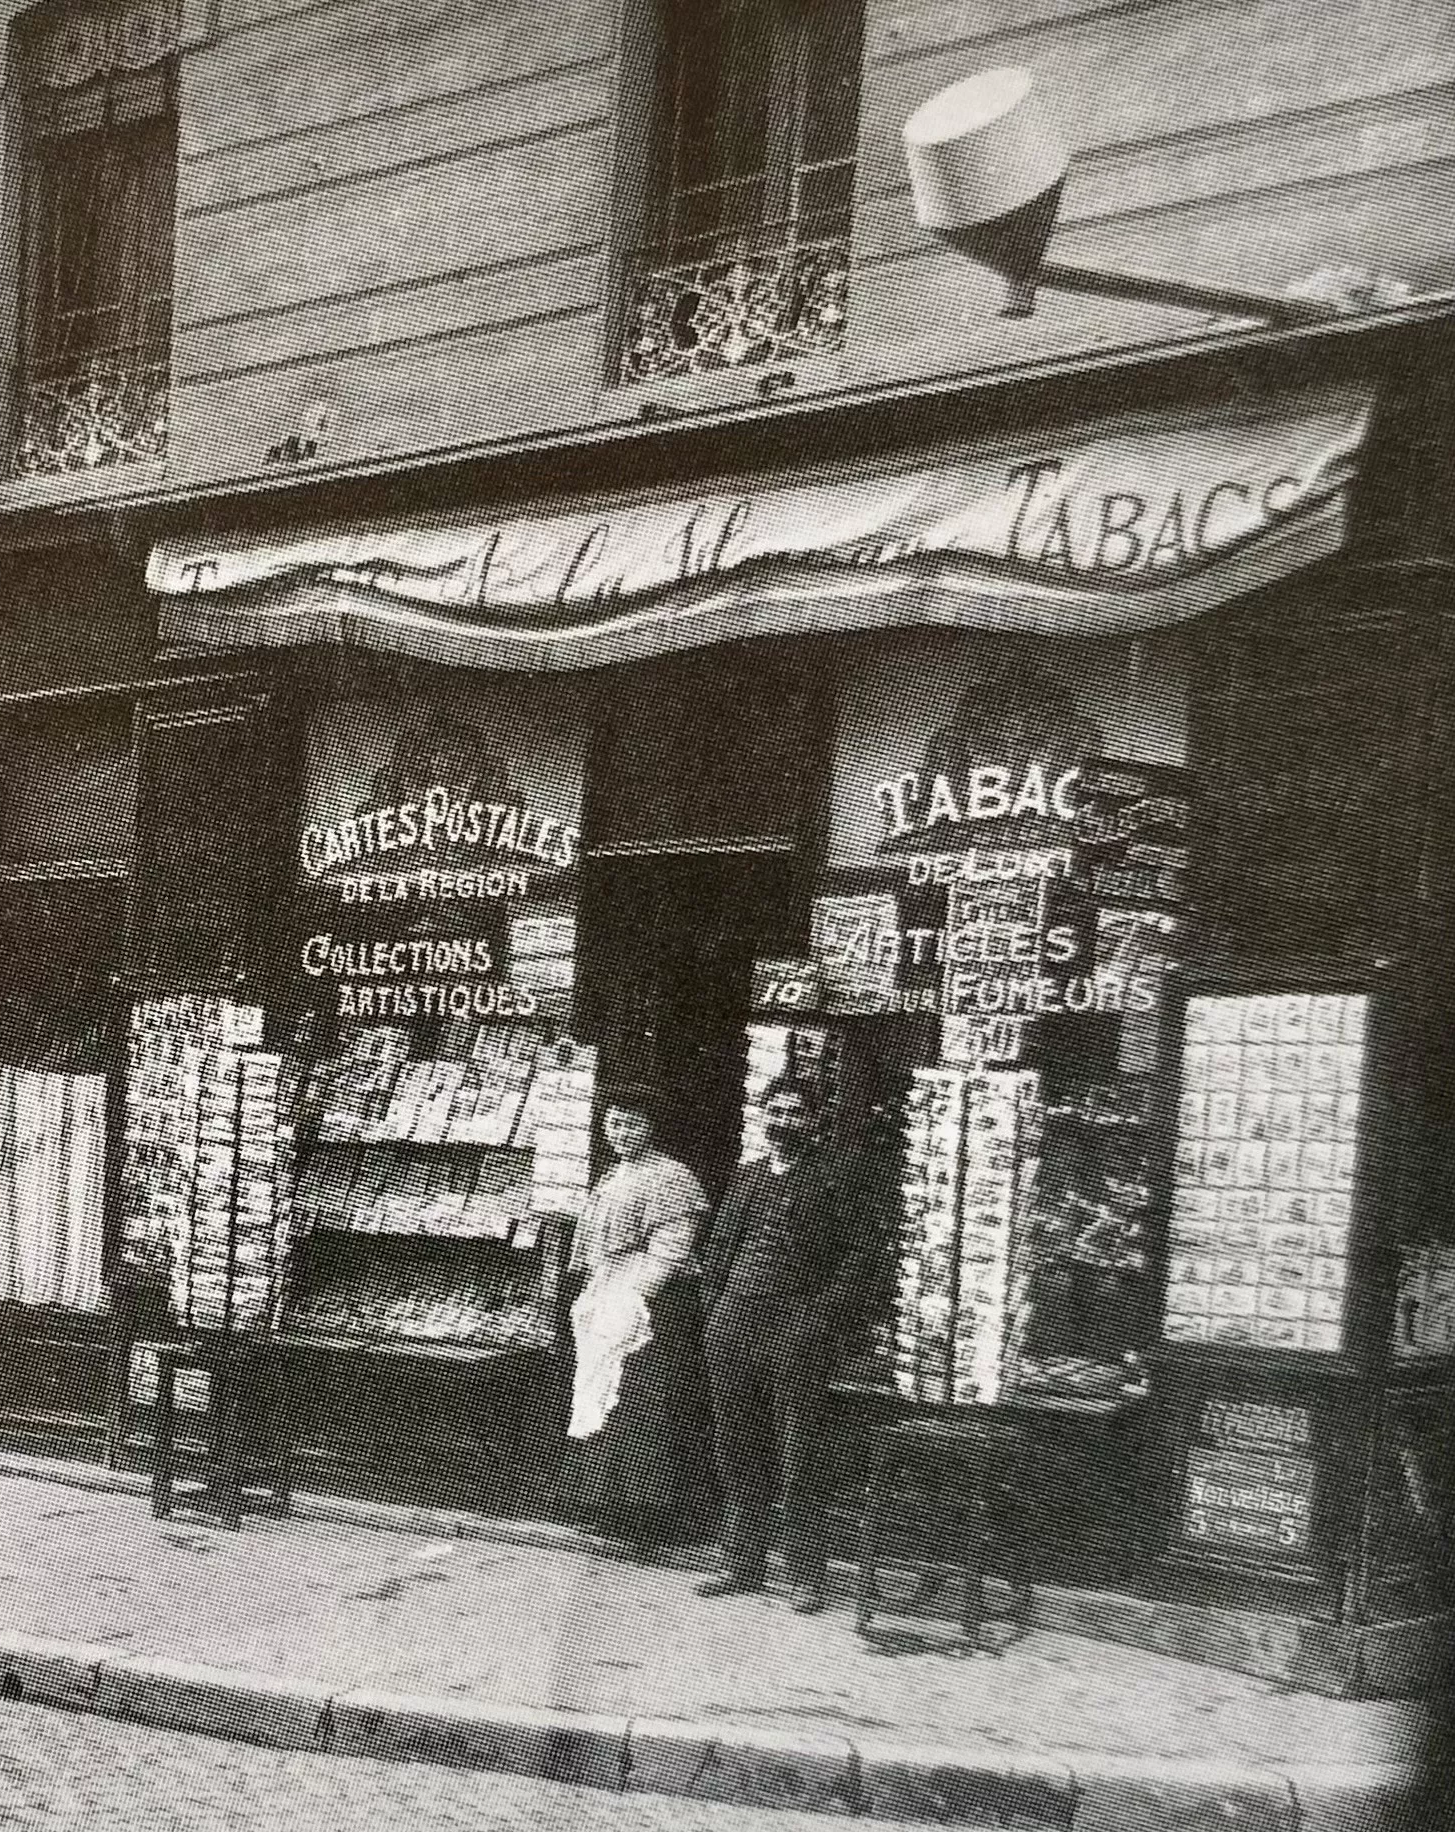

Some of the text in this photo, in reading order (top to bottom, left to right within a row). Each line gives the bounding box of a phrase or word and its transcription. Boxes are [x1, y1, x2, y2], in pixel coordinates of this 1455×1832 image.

[301, 784, 581, 878] CARTES POSTALES
[340, 868, 528, 904] DE LA REGION
[908, 853, 957, 886] DE
[302, 932, 493, 977] COLLECTIONS
[823, 922, 1077, 966] ARTICLES
[335, 982, 538, 1022] ARTISTIQUES
[953, 973, 1157, 1014] FUMEURS
